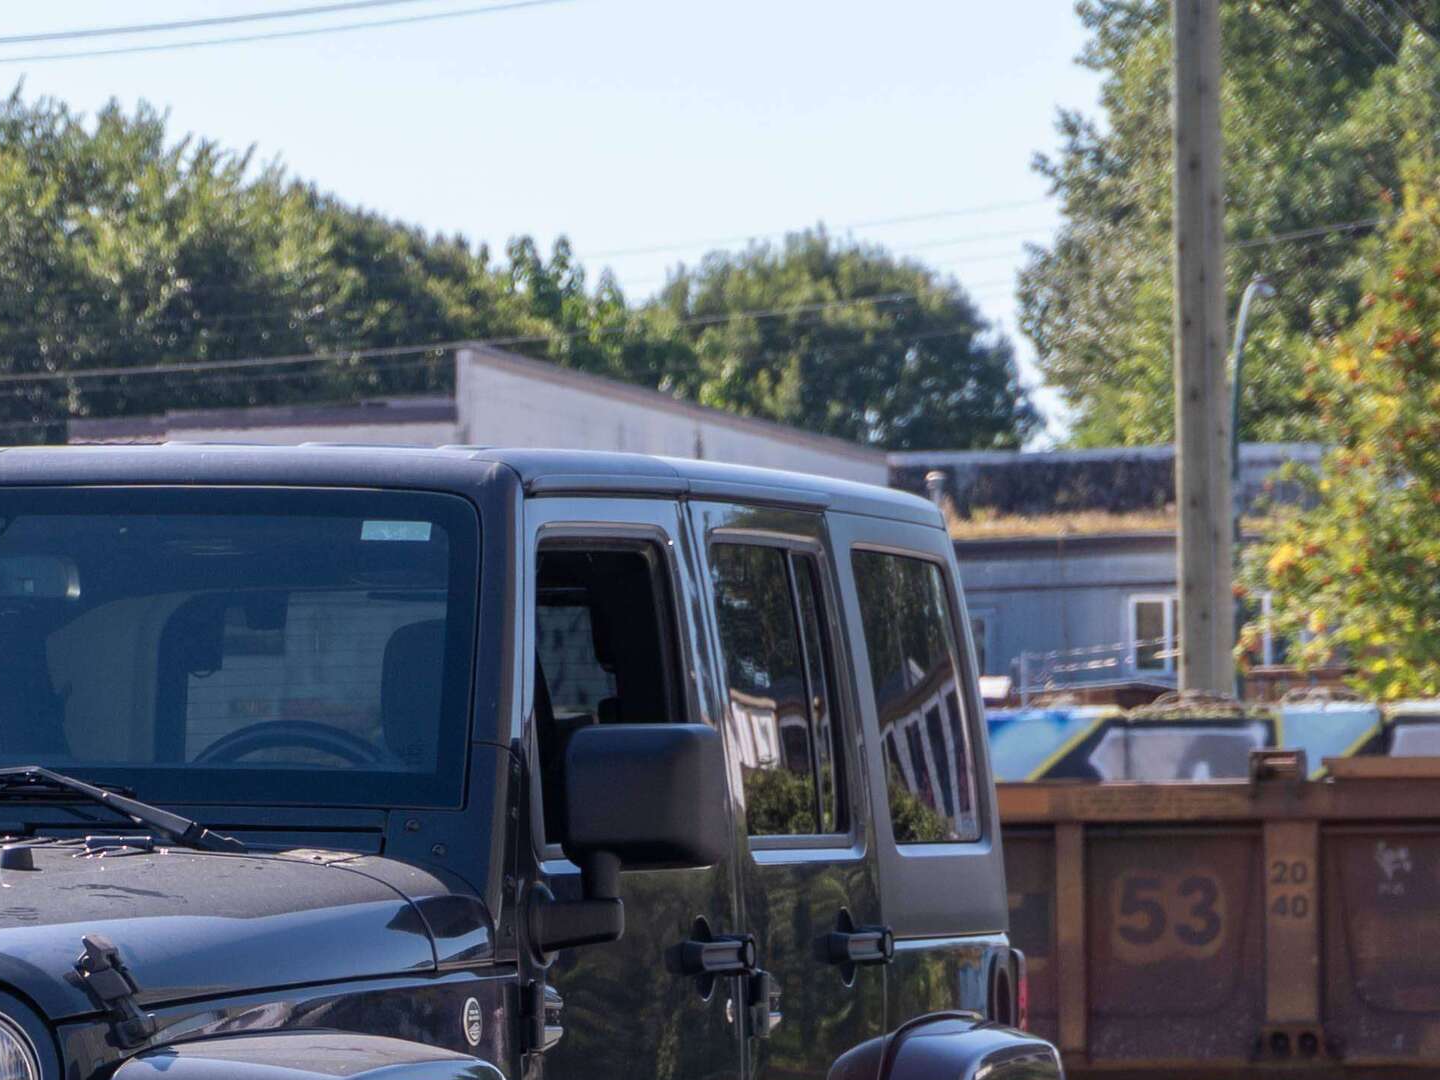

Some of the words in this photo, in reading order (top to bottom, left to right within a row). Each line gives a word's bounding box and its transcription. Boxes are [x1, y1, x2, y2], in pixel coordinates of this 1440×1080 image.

[1273, 861, 1308, 884] 20
[1118, 876, 1221, 946] 53
[1272, 895, 1308, 918] 40
